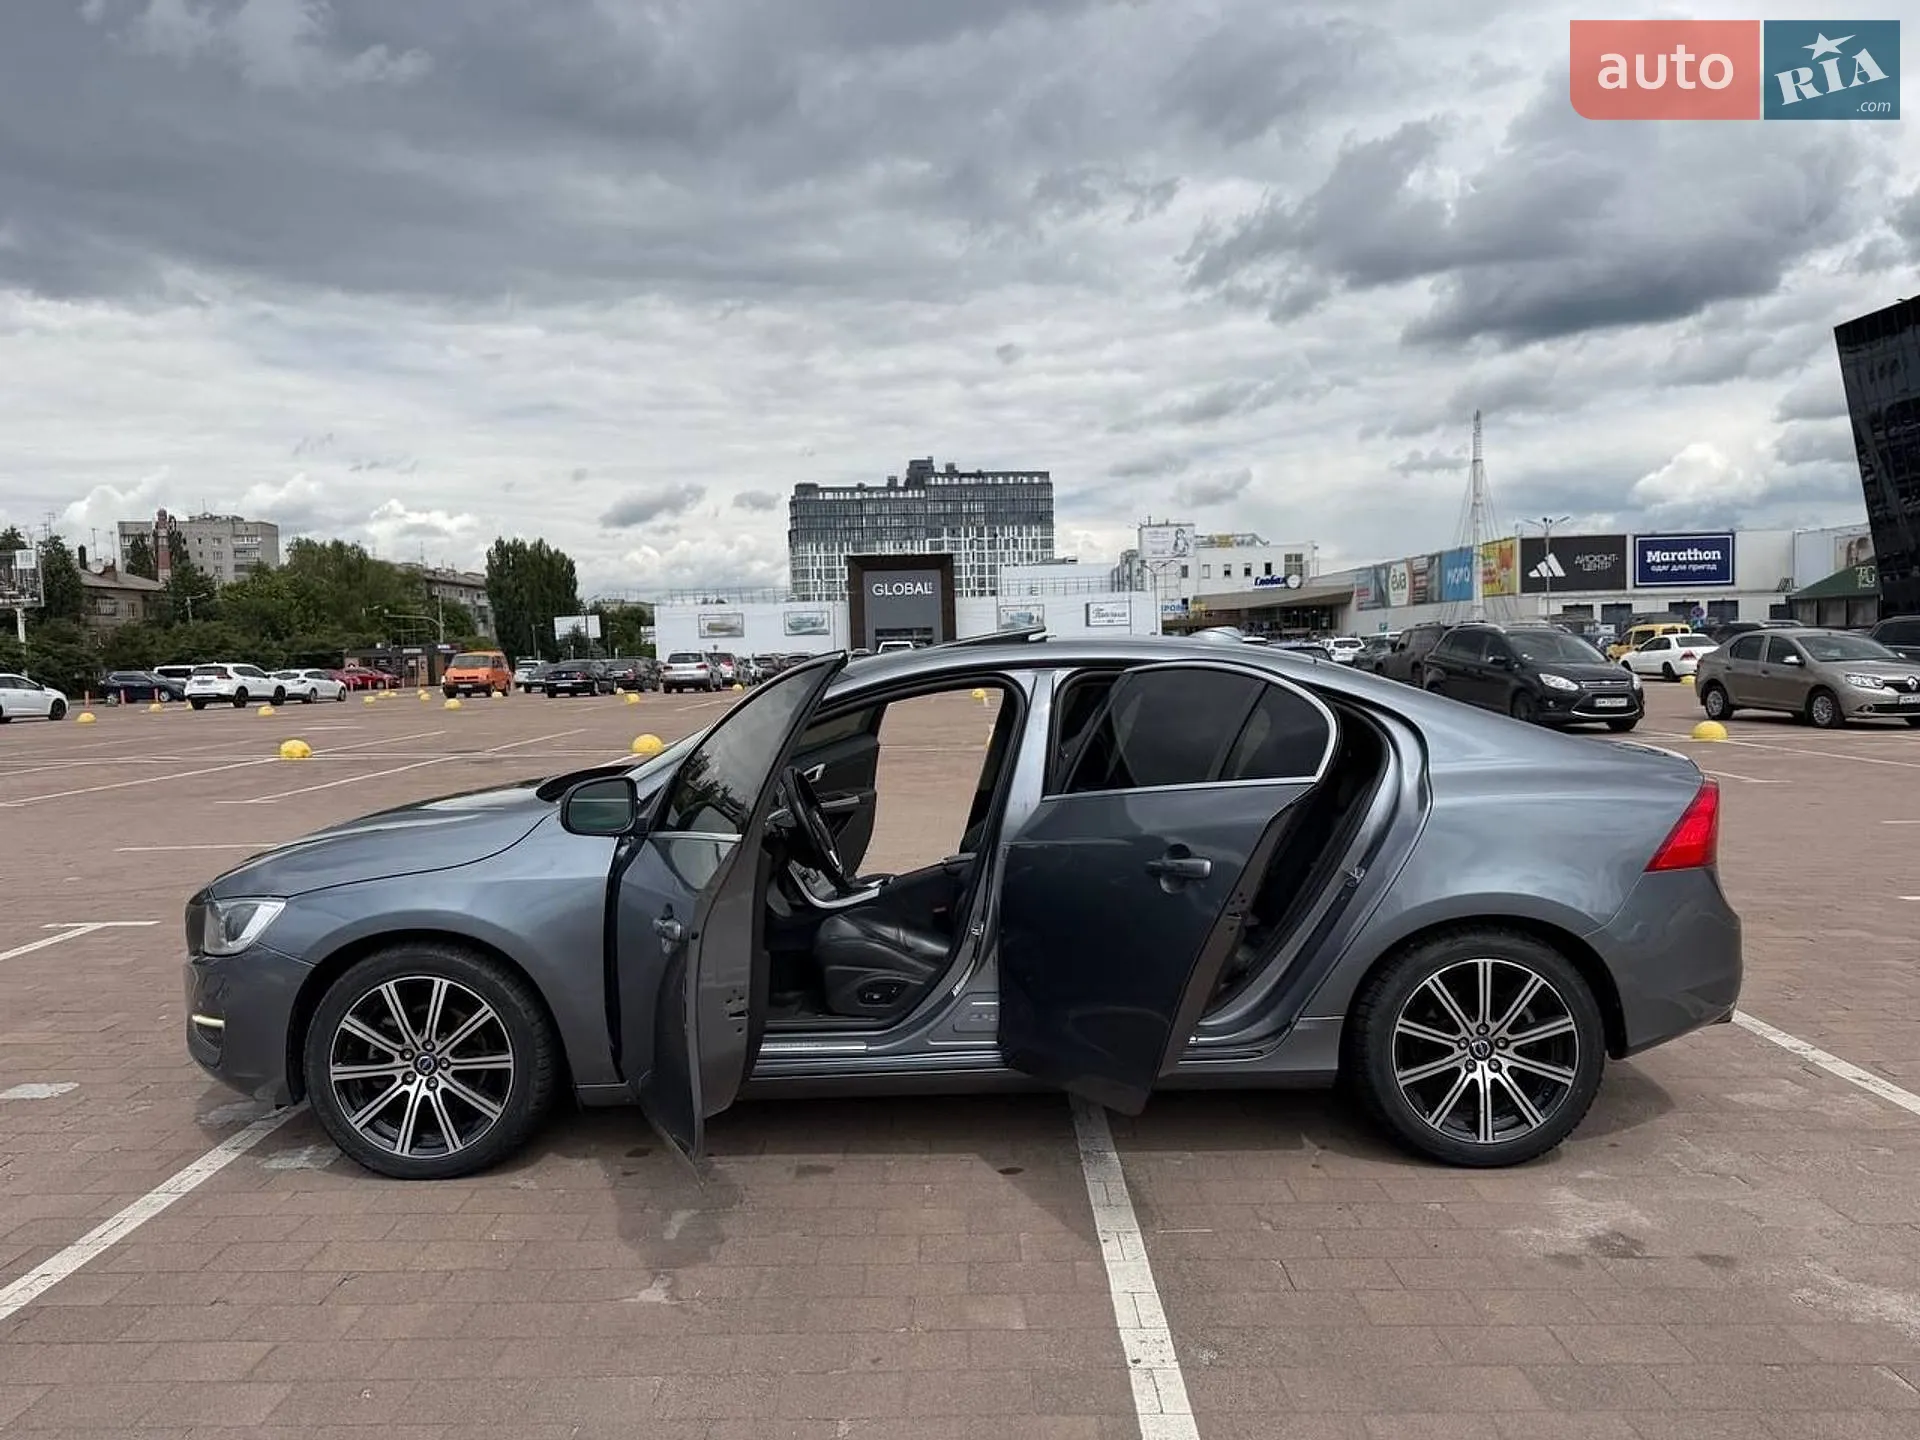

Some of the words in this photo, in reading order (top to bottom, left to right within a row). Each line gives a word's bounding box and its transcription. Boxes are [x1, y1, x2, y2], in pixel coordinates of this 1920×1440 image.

[1646, 548, 1722, 563] Marathon
[1671, 563, 1687, 571] для
[872, 582, 933, 596] GLOBAL
